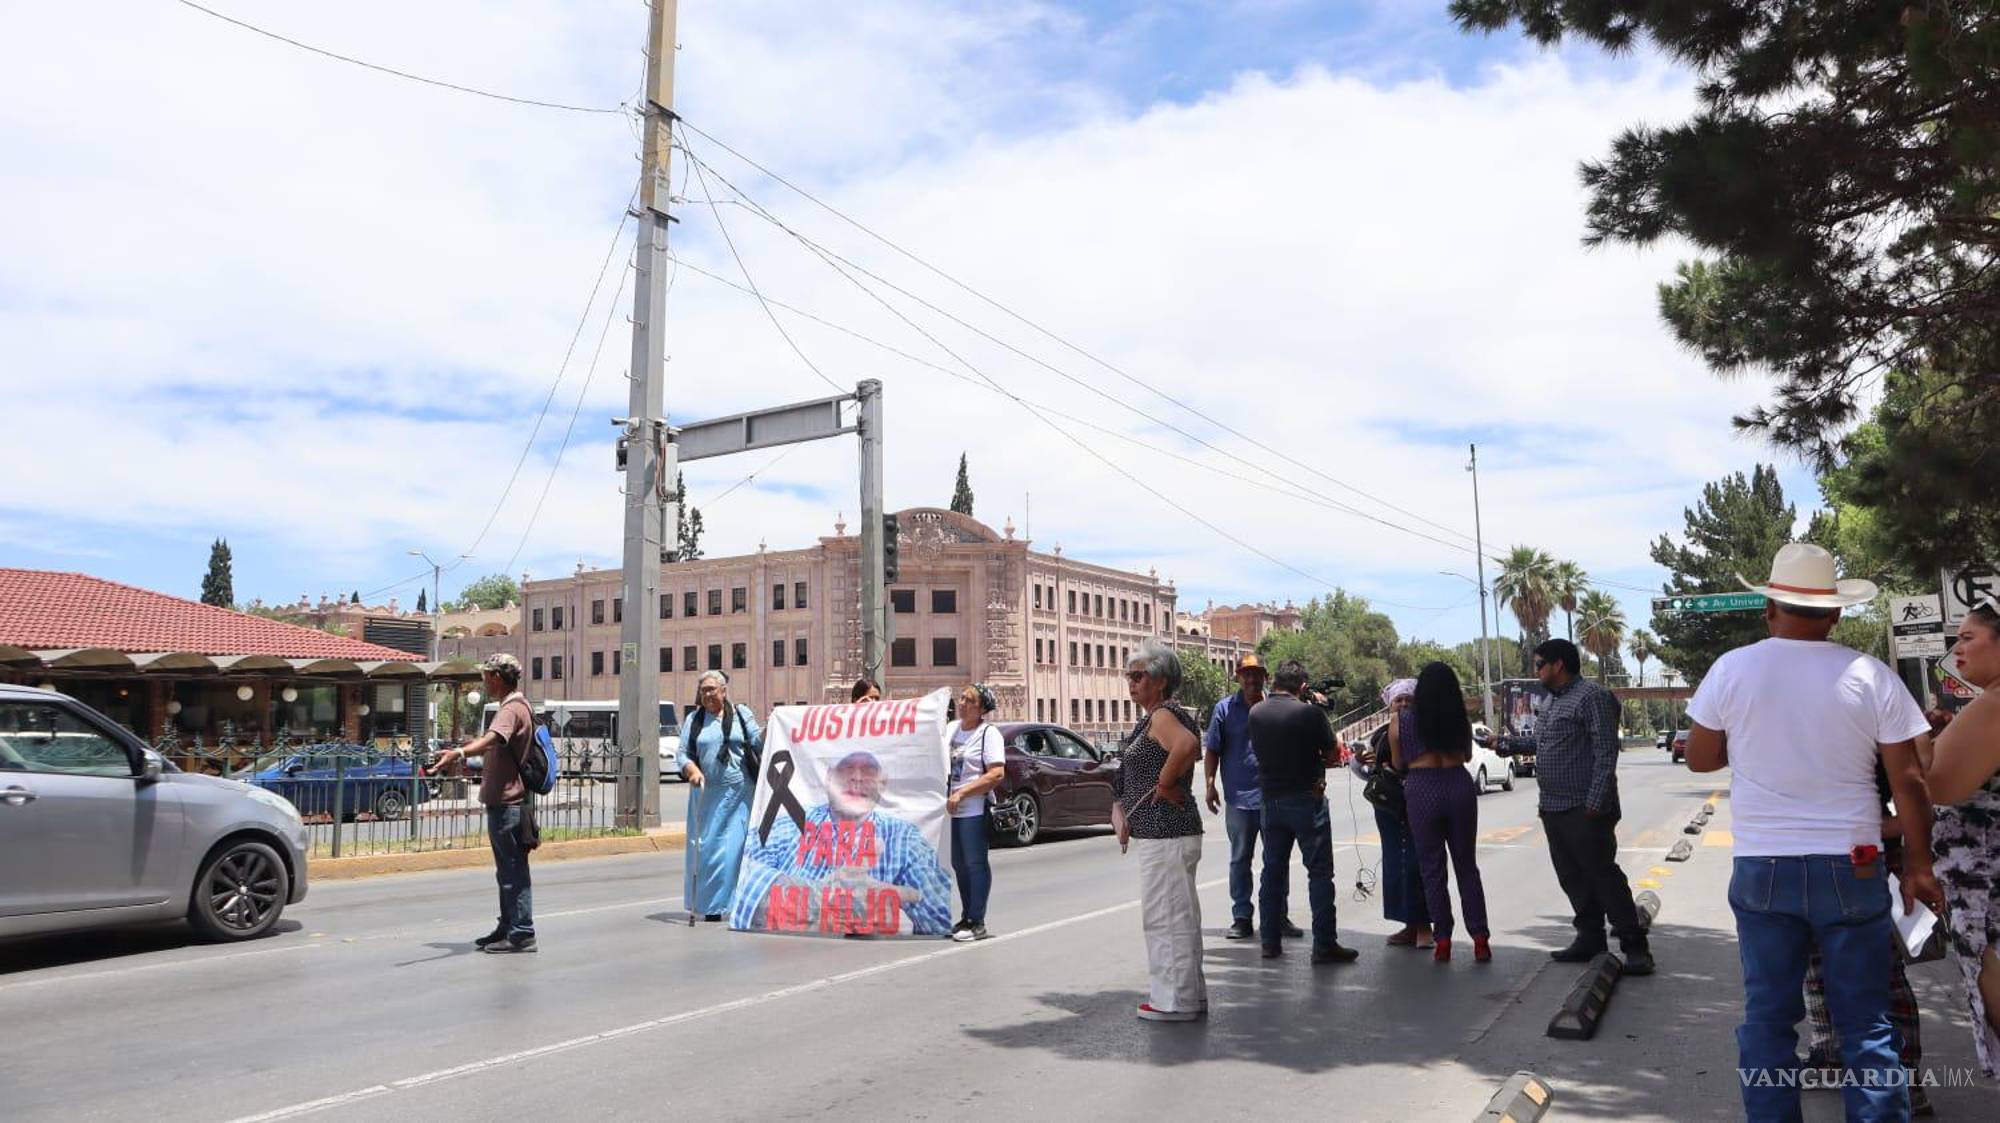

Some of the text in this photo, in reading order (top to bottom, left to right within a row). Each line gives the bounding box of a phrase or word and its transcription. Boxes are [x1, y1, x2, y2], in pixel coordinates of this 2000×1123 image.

[790, 698, 918, 744] JUSTICIA
[796, 819, 877, 867] PARA
[766, 883, 902, 935] MI HIJO
